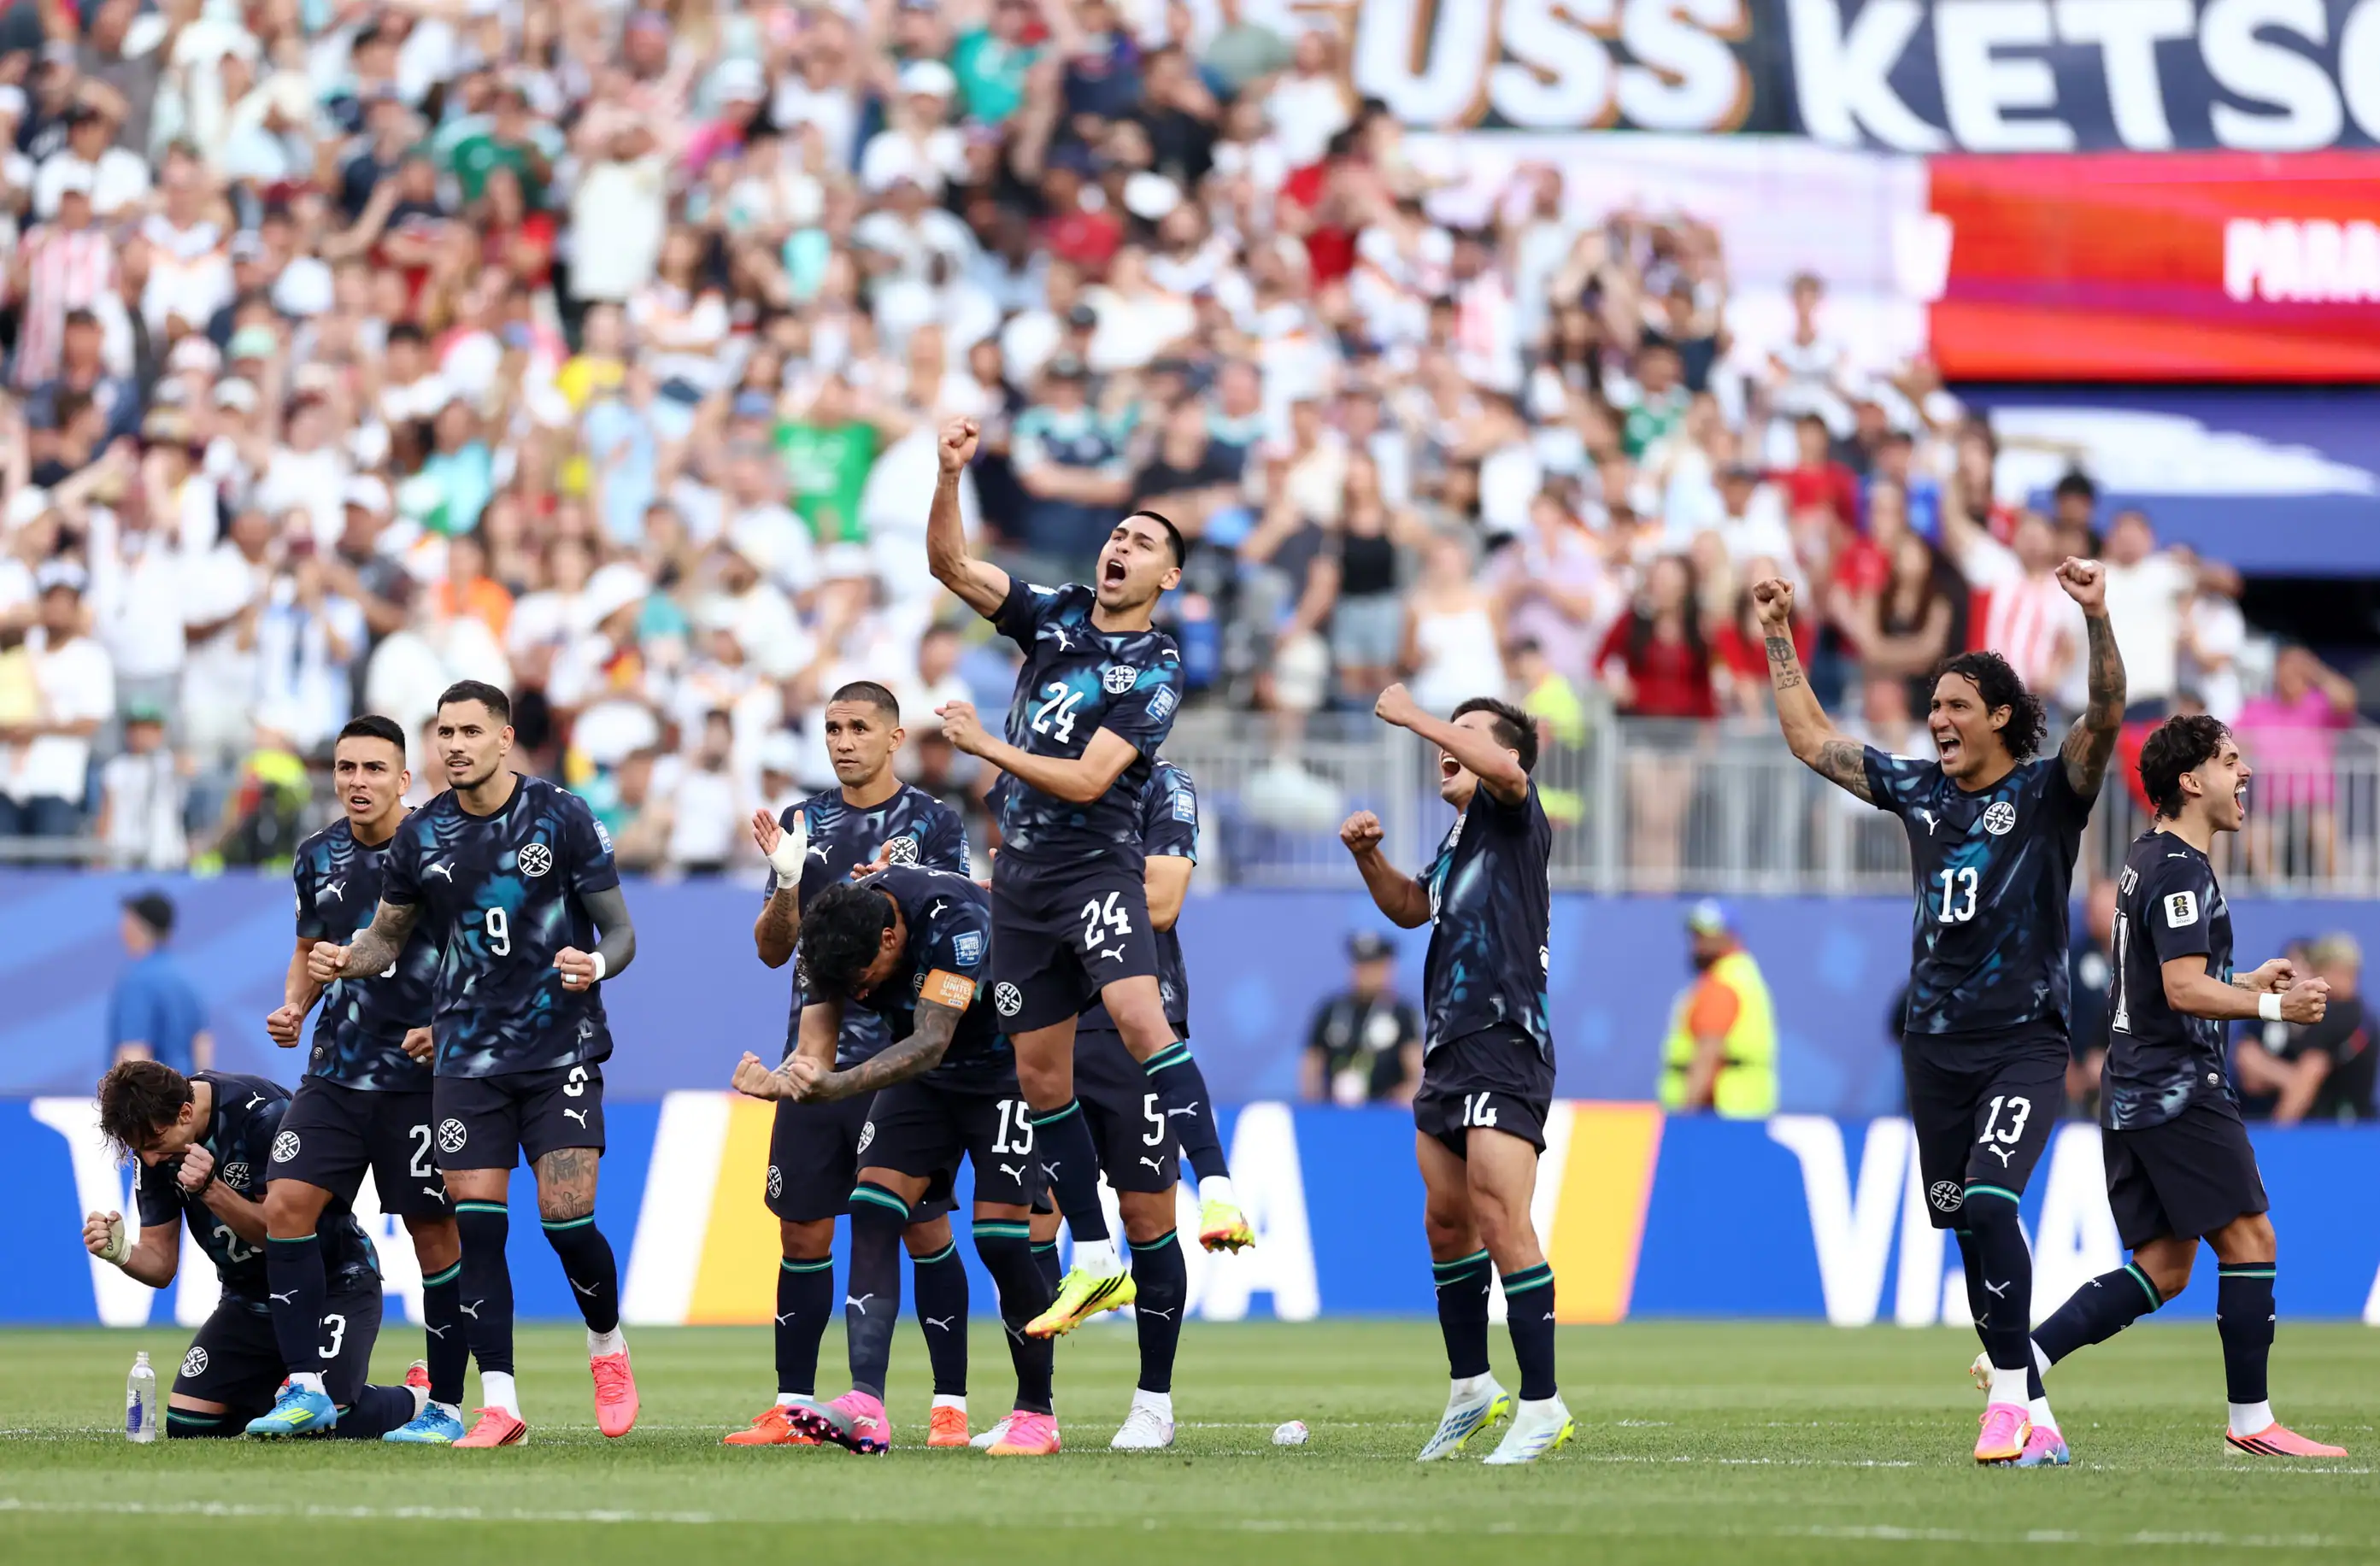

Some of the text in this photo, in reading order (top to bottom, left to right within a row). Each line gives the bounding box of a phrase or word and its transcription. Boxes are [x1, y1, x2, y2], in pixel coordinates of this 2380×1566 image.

[1031, 682, 1084, 744] 24
[1080, 891, 1132, 950] 24
[1938, 866, 1977, 923] 13
[485, 906, 511, 956] 9
[991, 1099, 1033, 1155] 15
[1143, 1093, 1165, 1146] 5
[1463, 1091, 1497, 1127] 14
[1978, 1095, 2031, 1144] 13
[409, 1124, 443, 1176] 2
[214, 1224, 262, 1263] 2
[319, 1313, 346, 1359] 3
